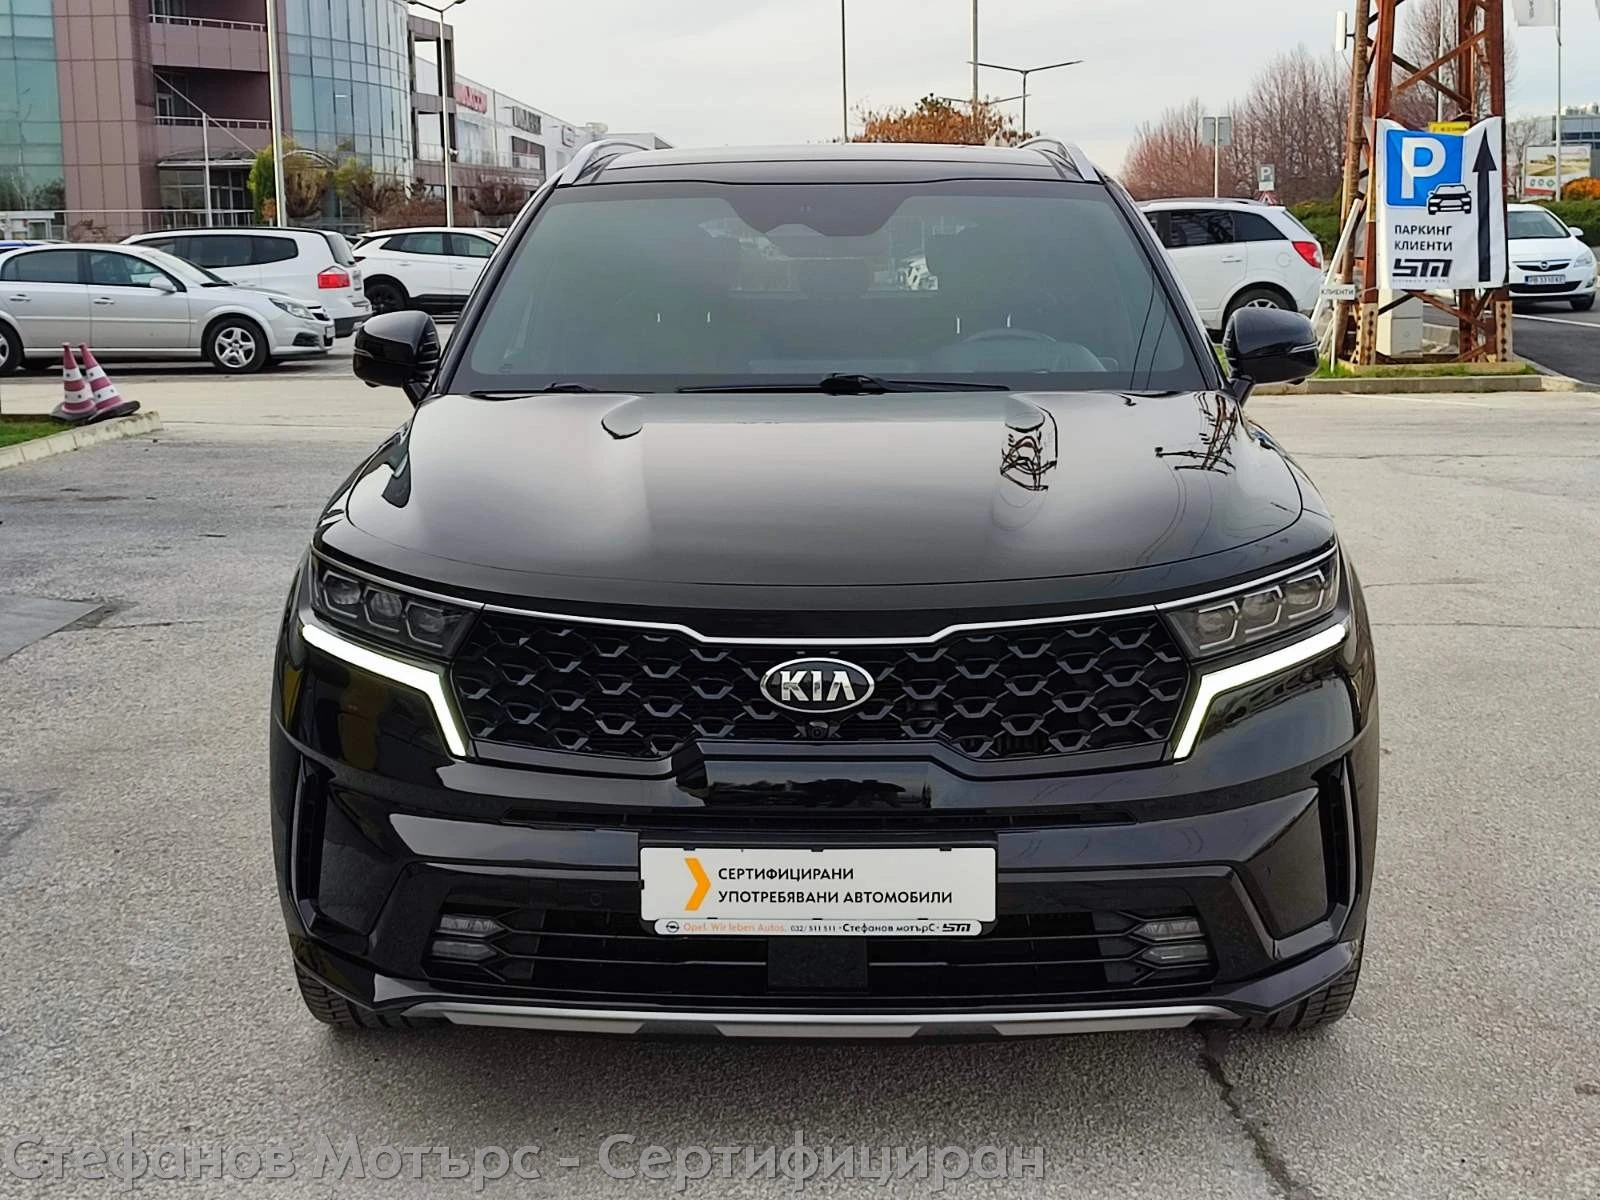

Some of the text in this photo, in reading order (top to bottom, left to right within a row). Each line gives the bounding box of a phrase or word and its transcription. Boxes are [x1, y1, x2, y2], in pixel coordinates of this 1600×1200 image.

[1401, 137, 1446, 199] P
[1394, 225, 1452, 236] ПАРКИНГ
[1394, 241, 1453, 252] КЛИЕНТИ
[780, 670, 856, 701] KIA
[718, 868, 854, 881] СЕРТИФИЦИРАНИ
[718, 891, 952, 903] УПОТРЕБЯВАНИ АВТОМОБИЛИ
